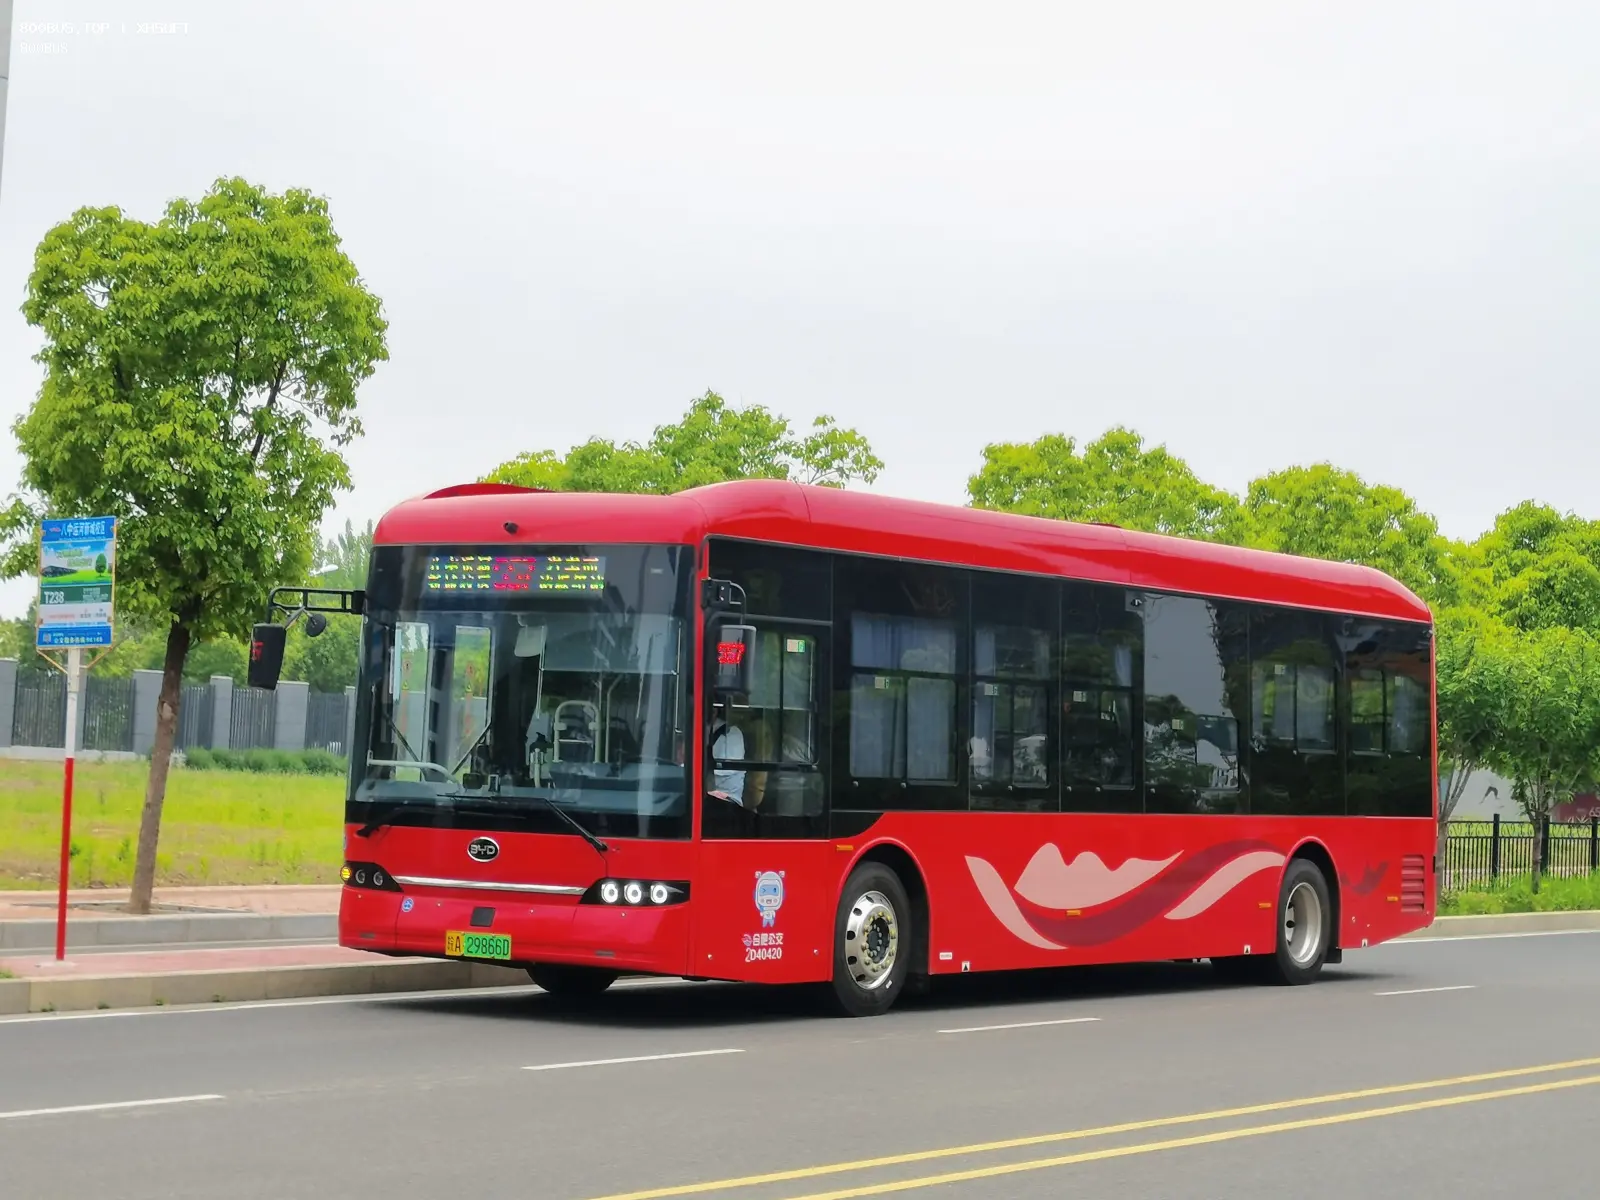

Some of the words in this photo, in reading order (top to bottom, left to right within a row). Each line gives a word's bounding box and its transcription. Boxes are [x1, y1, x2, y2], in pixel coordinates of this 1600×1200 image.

[470, 844, 496, 855] BYD
[752, 932, 784, 946] 合肥公交
[744, 947, 783, 963] 2D40420
